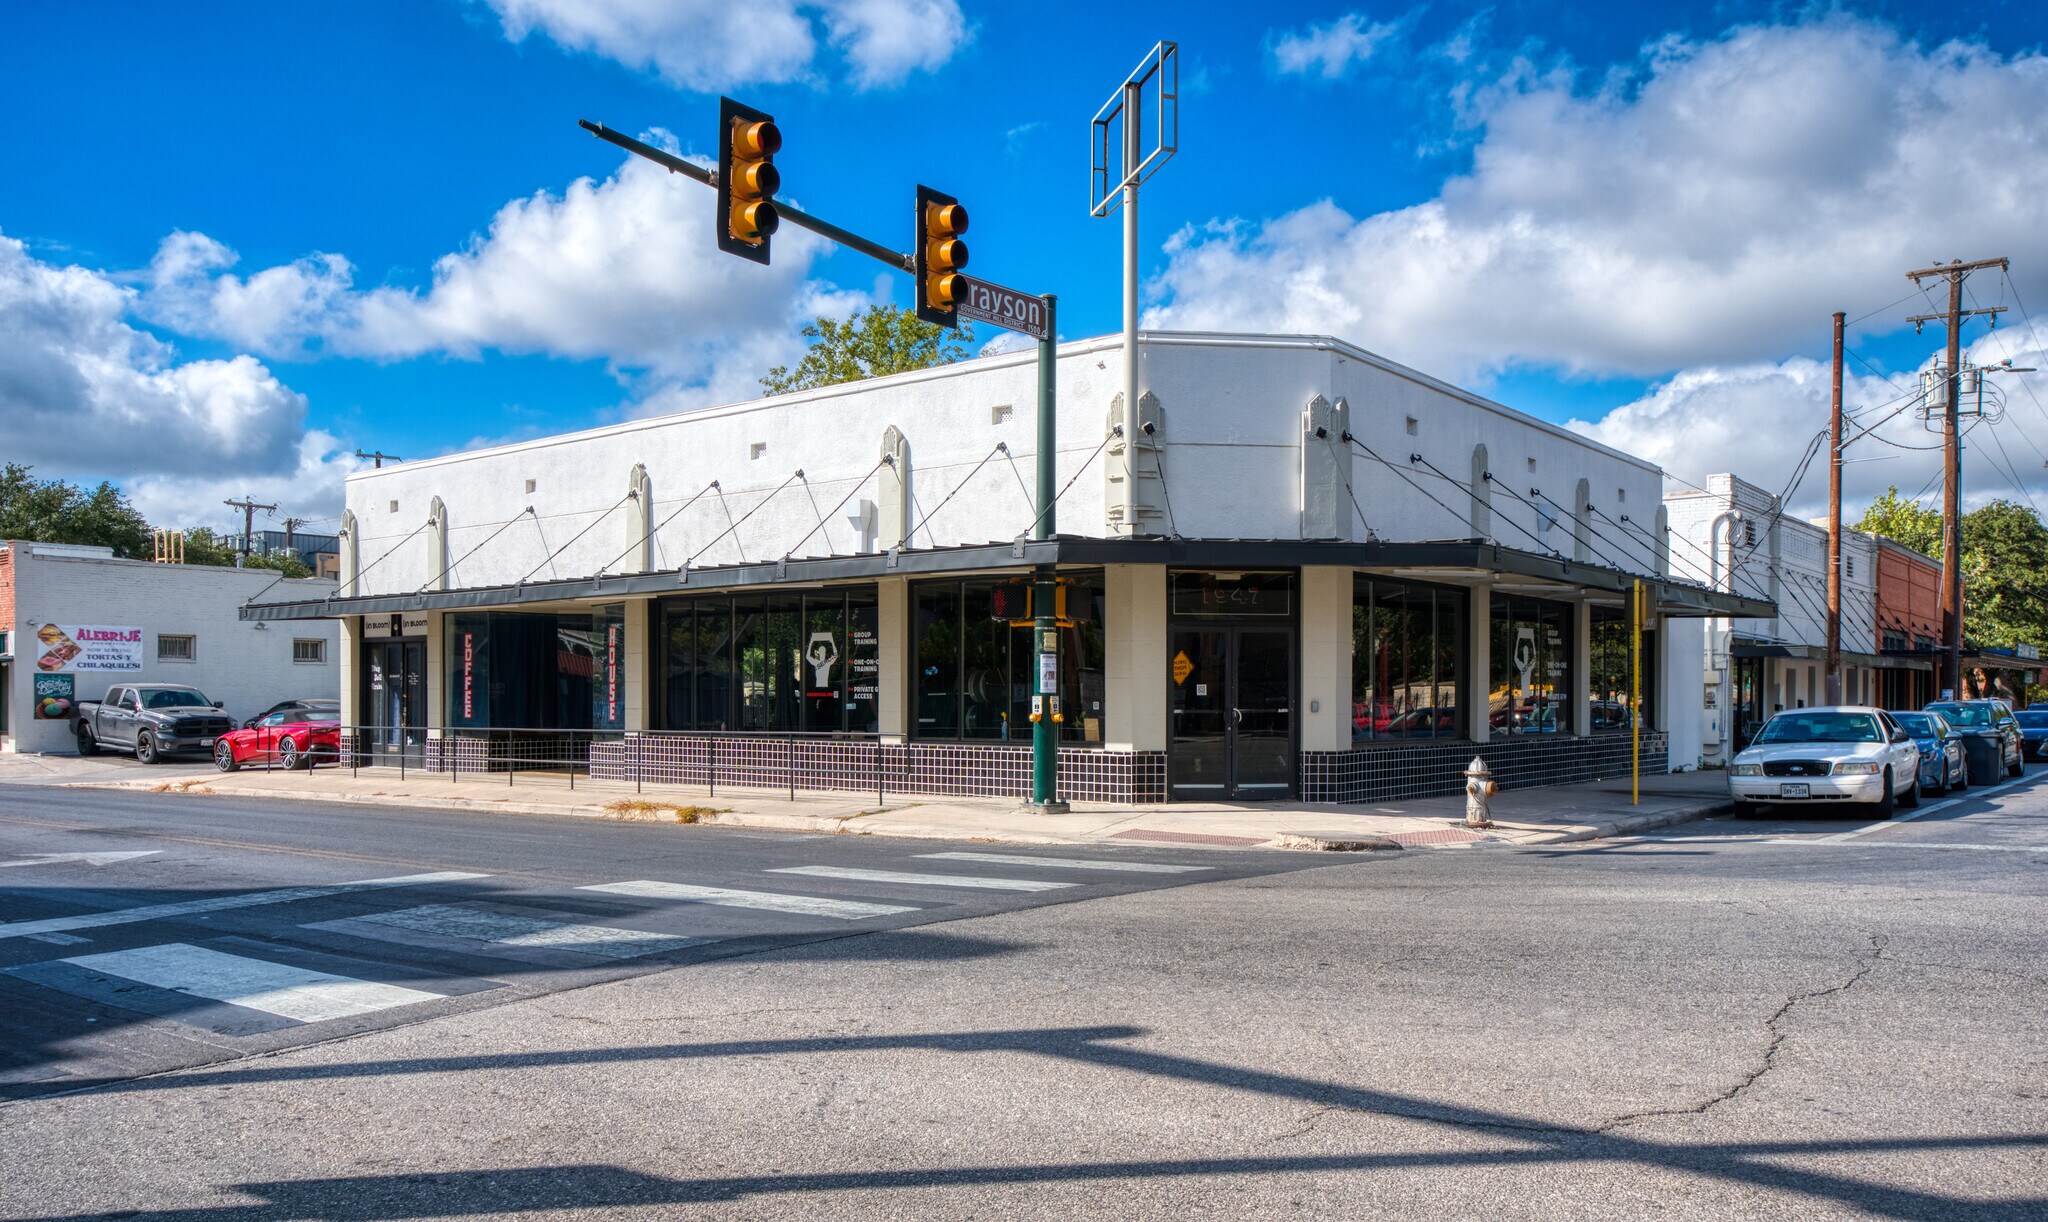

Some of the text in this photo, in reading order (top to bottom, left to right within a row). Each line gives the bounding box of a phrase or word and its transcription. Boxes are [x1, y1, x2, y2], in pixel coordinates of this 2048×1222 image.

[960, 304, 1026, 329] GOVERNMENT HILL DISTRICT
[970, 284, 1040, 325] rayson
[1027, 324, 1041, 336] 1500
[76, 628, 142, 642] ALEBRIJE
[464, 632, 473, 719] COFFEE
[608, 625, 617, 722] HOUSE
